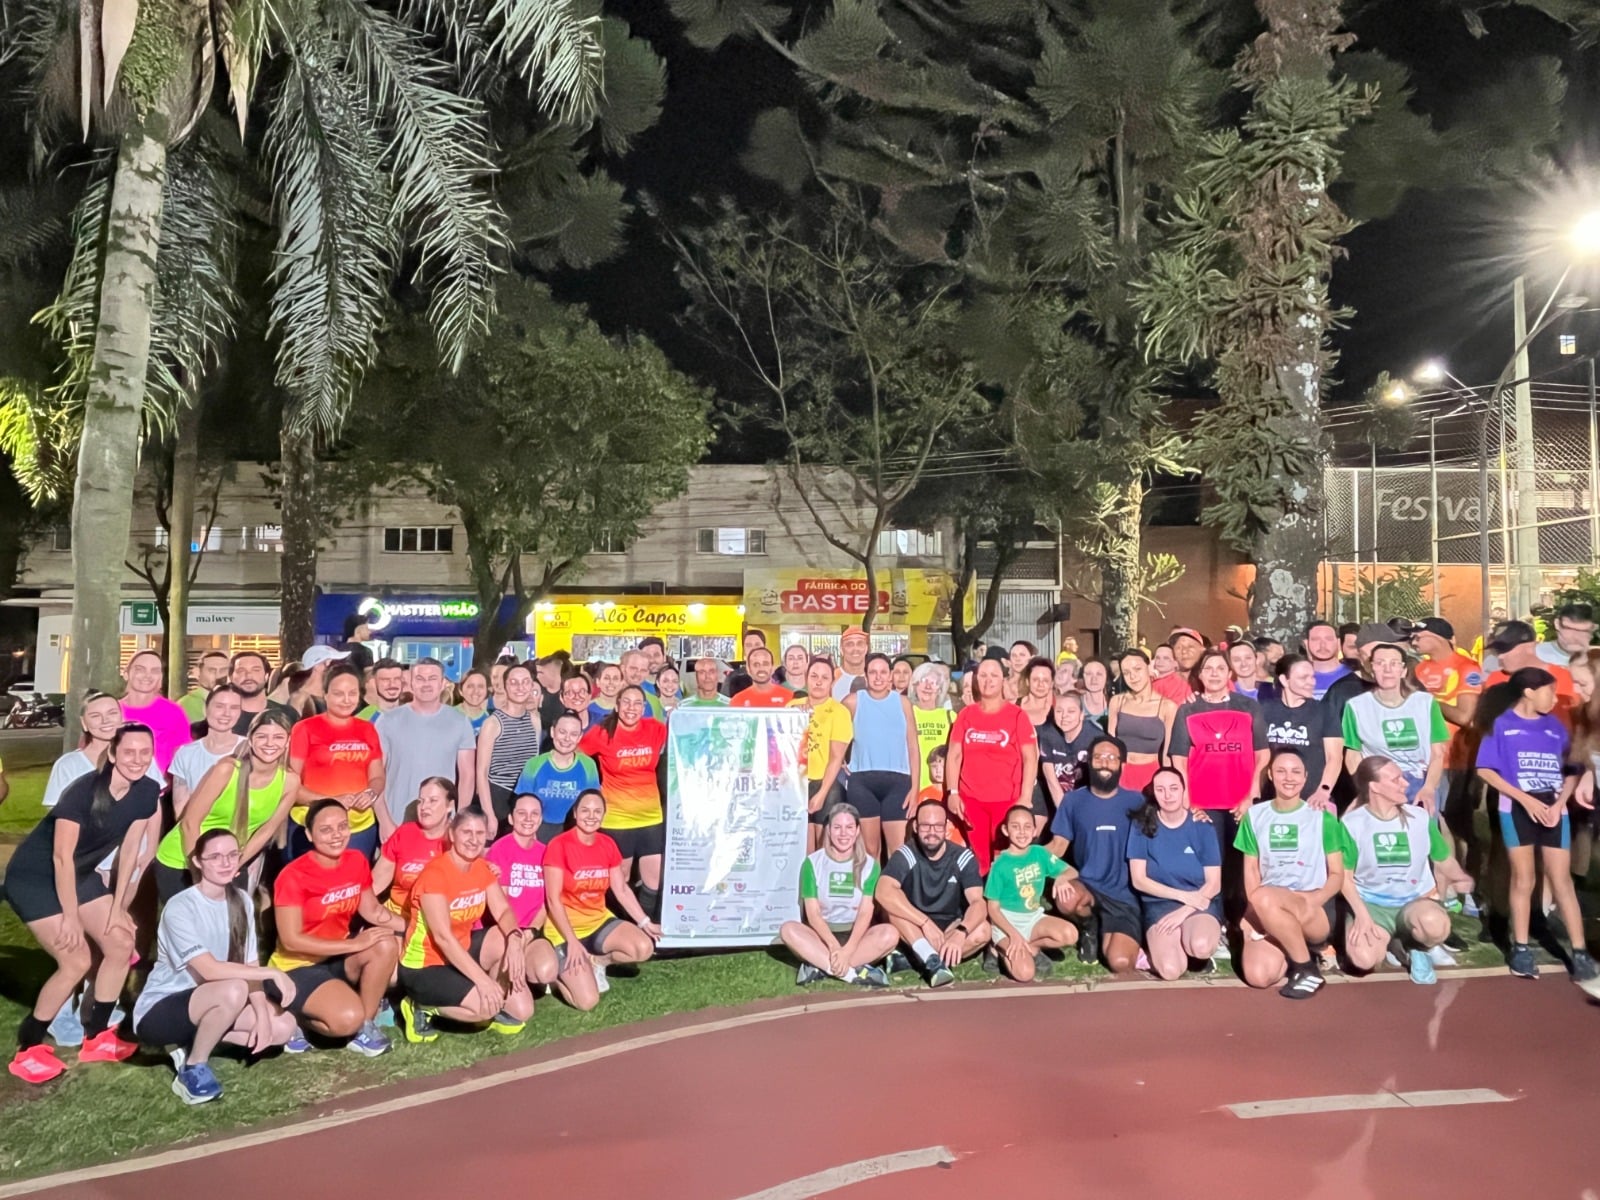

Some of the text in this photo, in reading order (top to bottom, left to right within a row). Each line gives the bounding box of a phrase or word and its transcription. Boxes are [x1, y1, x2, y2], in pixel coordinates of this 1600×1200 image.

[805, 580, 867, 590] FÁBRICA DO
[195, 614, 236, 623] malwee
[632, 608, 687, 627] Capas
[618, 756, 652, 769] RUN
[1519, 759, 1558, 769] GANHA
